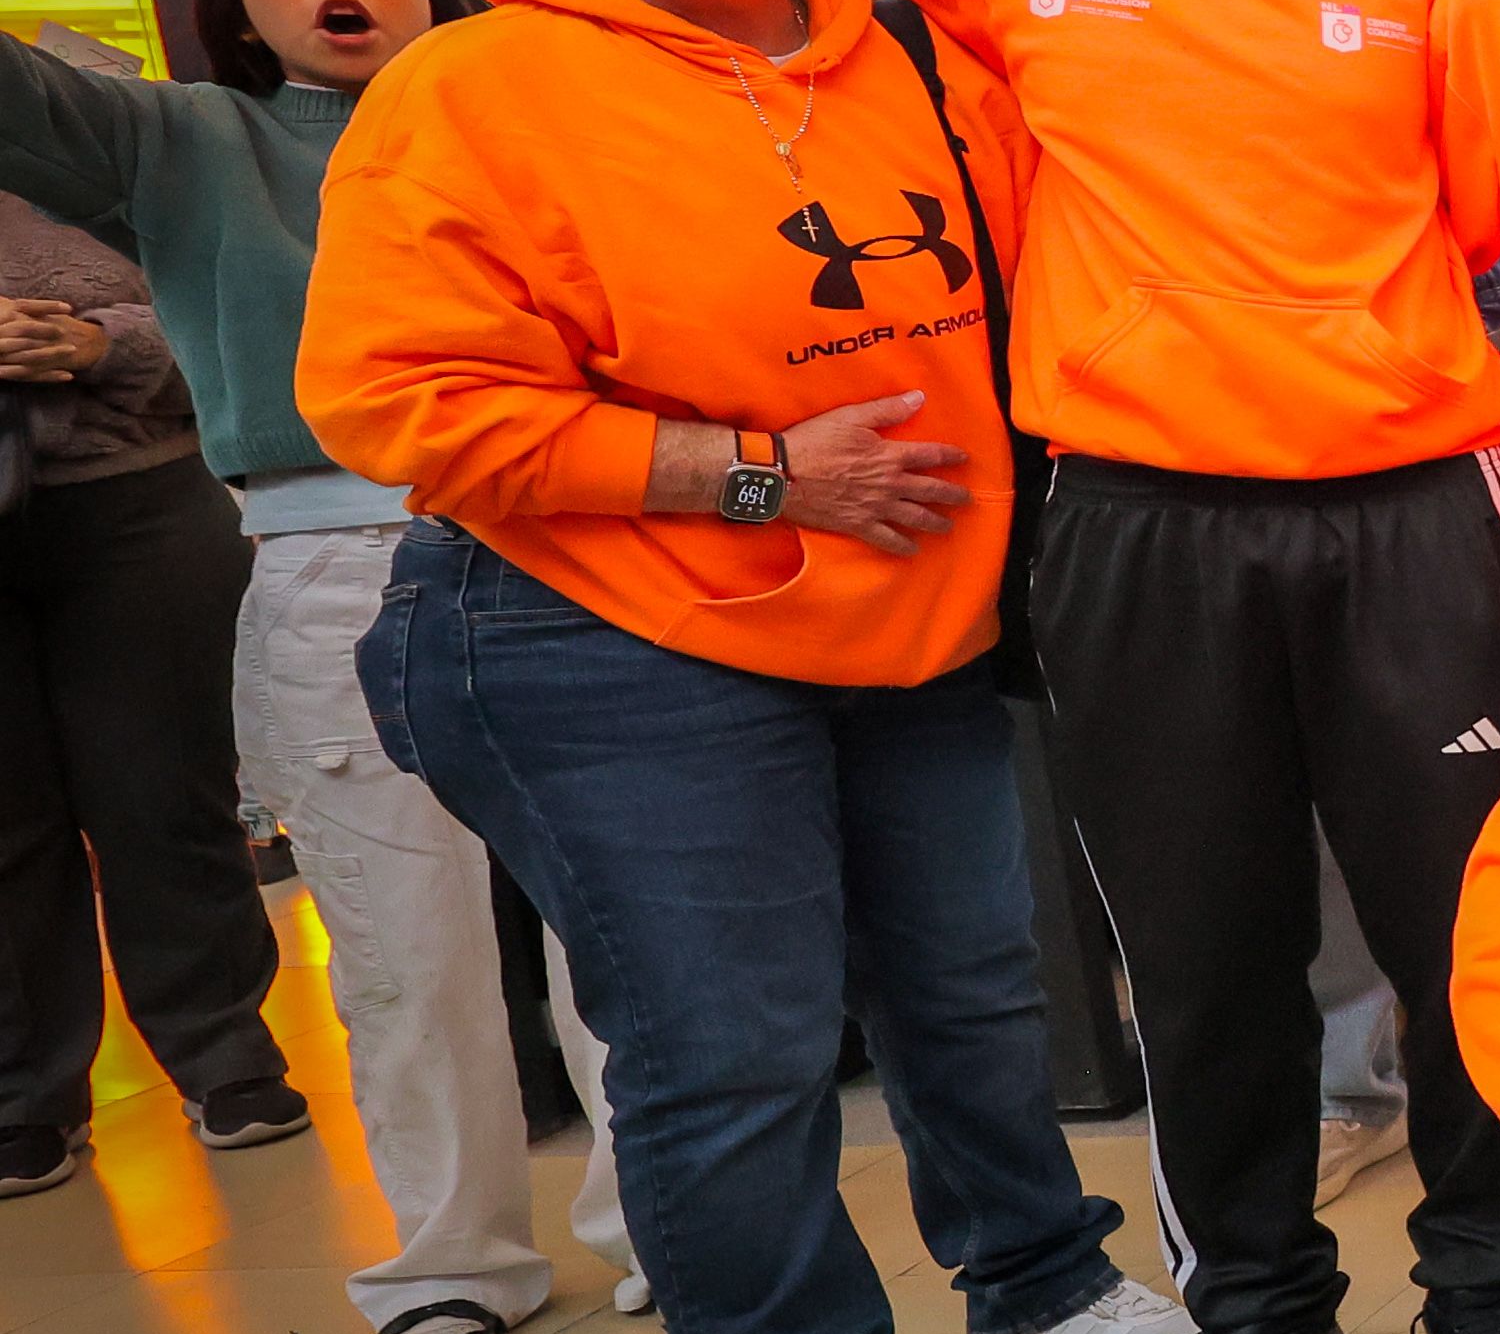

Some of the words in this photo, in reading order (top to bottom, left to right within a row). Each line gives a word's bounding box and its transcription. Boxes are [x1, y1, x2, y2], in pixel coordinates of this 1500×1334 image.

[787, 324, 895, 365] UNDER
[907, 308, 984, 339] ARMOU
[738, 484, 766, 505] 1:59
